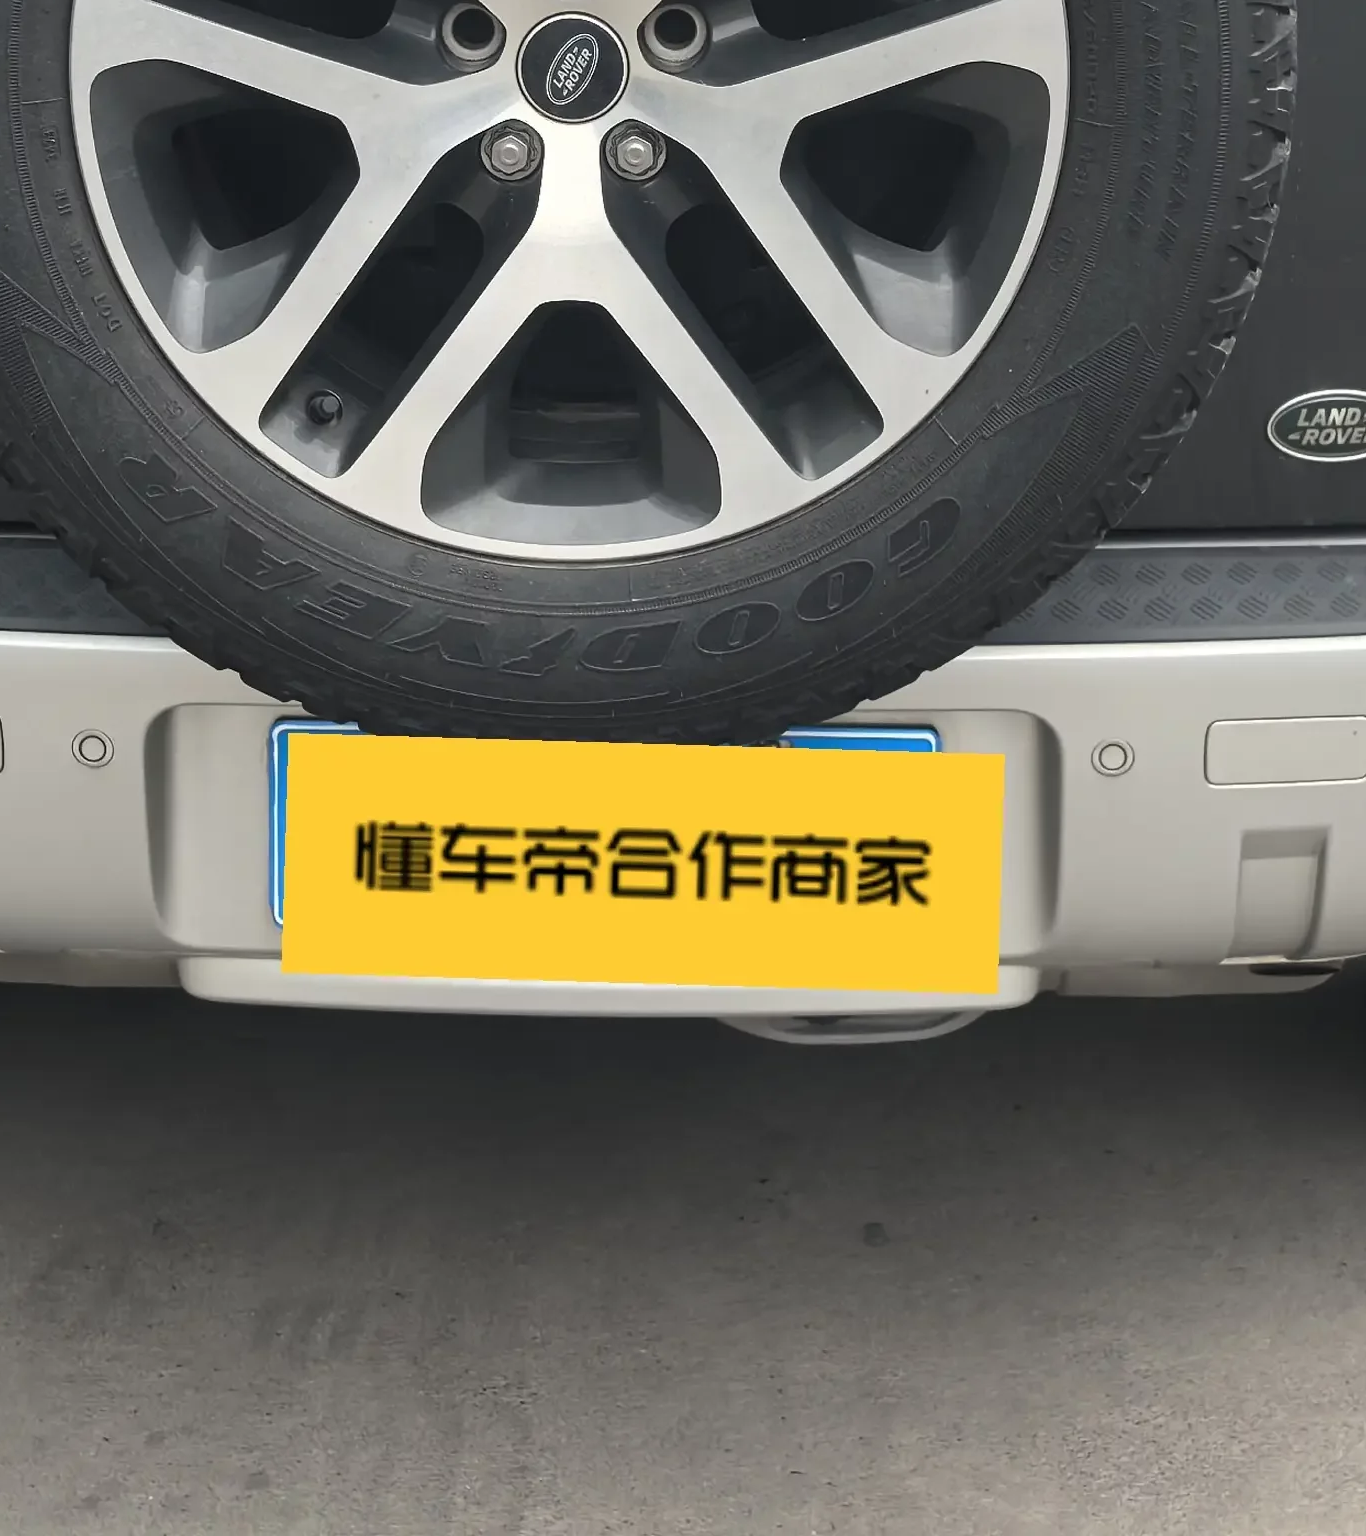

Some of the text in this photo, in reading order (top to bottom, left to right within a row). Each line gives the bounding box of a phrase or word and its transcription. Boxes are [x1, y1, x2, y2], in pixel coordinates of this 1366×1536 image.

[553, 52, 577, 89] LAND
[565, 48, 593, 92] ROVER
[1297, 407, 1362, 427] LAND
[119, 454, 963, 678] GOODYEAR
